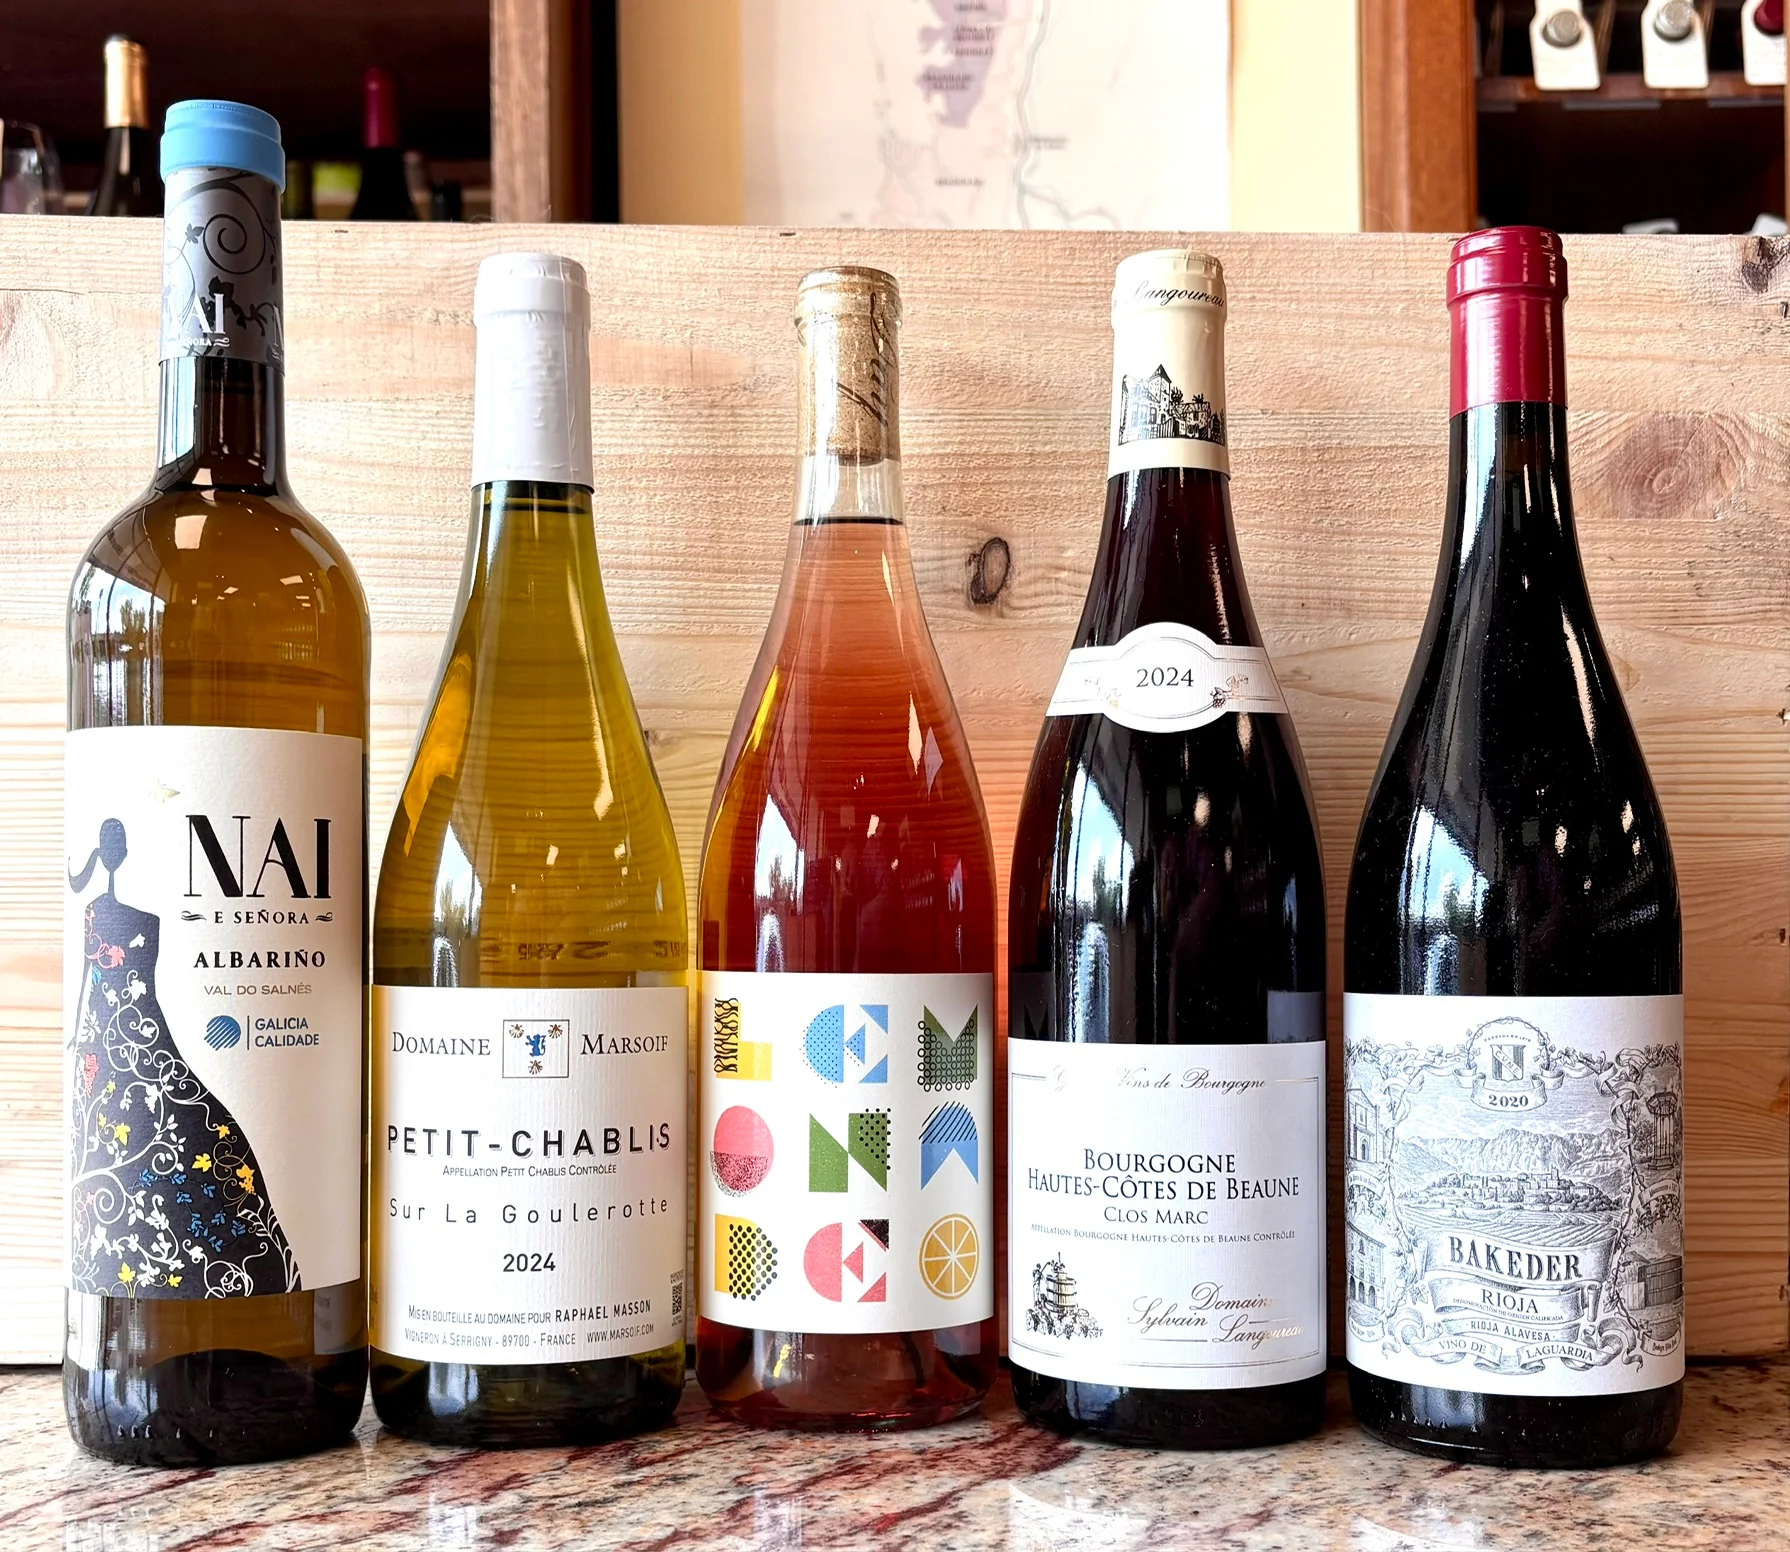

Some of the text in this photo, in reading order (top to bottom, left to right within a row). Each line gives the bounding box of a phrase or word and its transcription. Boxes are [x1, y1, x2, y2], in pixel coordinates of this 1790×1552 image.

[1136, 667, 1195, 688] 2024
[185, 815, 332, 899] NAI
[215, 909, 309, 924] E SEÑORA
[193, 947, 326, 968] ALBARIÑO
[205, 982, 312, 995] VAL DO SALNÉS
[255, 1019, 308, 1030] GALICIA
[255, 1033, 320, 1048] CALIDADE
[1155, 1073, 1171, 1088] de
[1181, 1068, 1266, 1094] Bourgogne
[1488, 1094, 1529, 1108] 2020
[388, 1123, 671, 1158] PETIT-CHABLIS
[1188, 1182, 1216, 1200] DE
[389, 1197, 668, 1224] Sur La Goulerotte
[503, 1253, 556, 1272] 2024
[1449, 1236, 1583, 1282] BAKEDER
[432, 1311, 472, 1323] BOUTEILLE
[474, 1313, 486, 1324] AU
[488, 1313, 527, 1324] DOMAINE
[528, 1312, 551, 1324] POUR
[555, 1306, 608, 1322] RAPHAEL
[613, 1299, 651, 1317] MASSON
[1482, 1289, 1538, 1314] RIOJA
[1127, 1296, 1208, 1334] Sylvain
[502, 1334, 529, 1346] 89700
[1470, 1321, 1551, 1341] RIOJA ALAVESA
[1439, 1339, 1593, 1361] VINO DE LAGUARDIA
